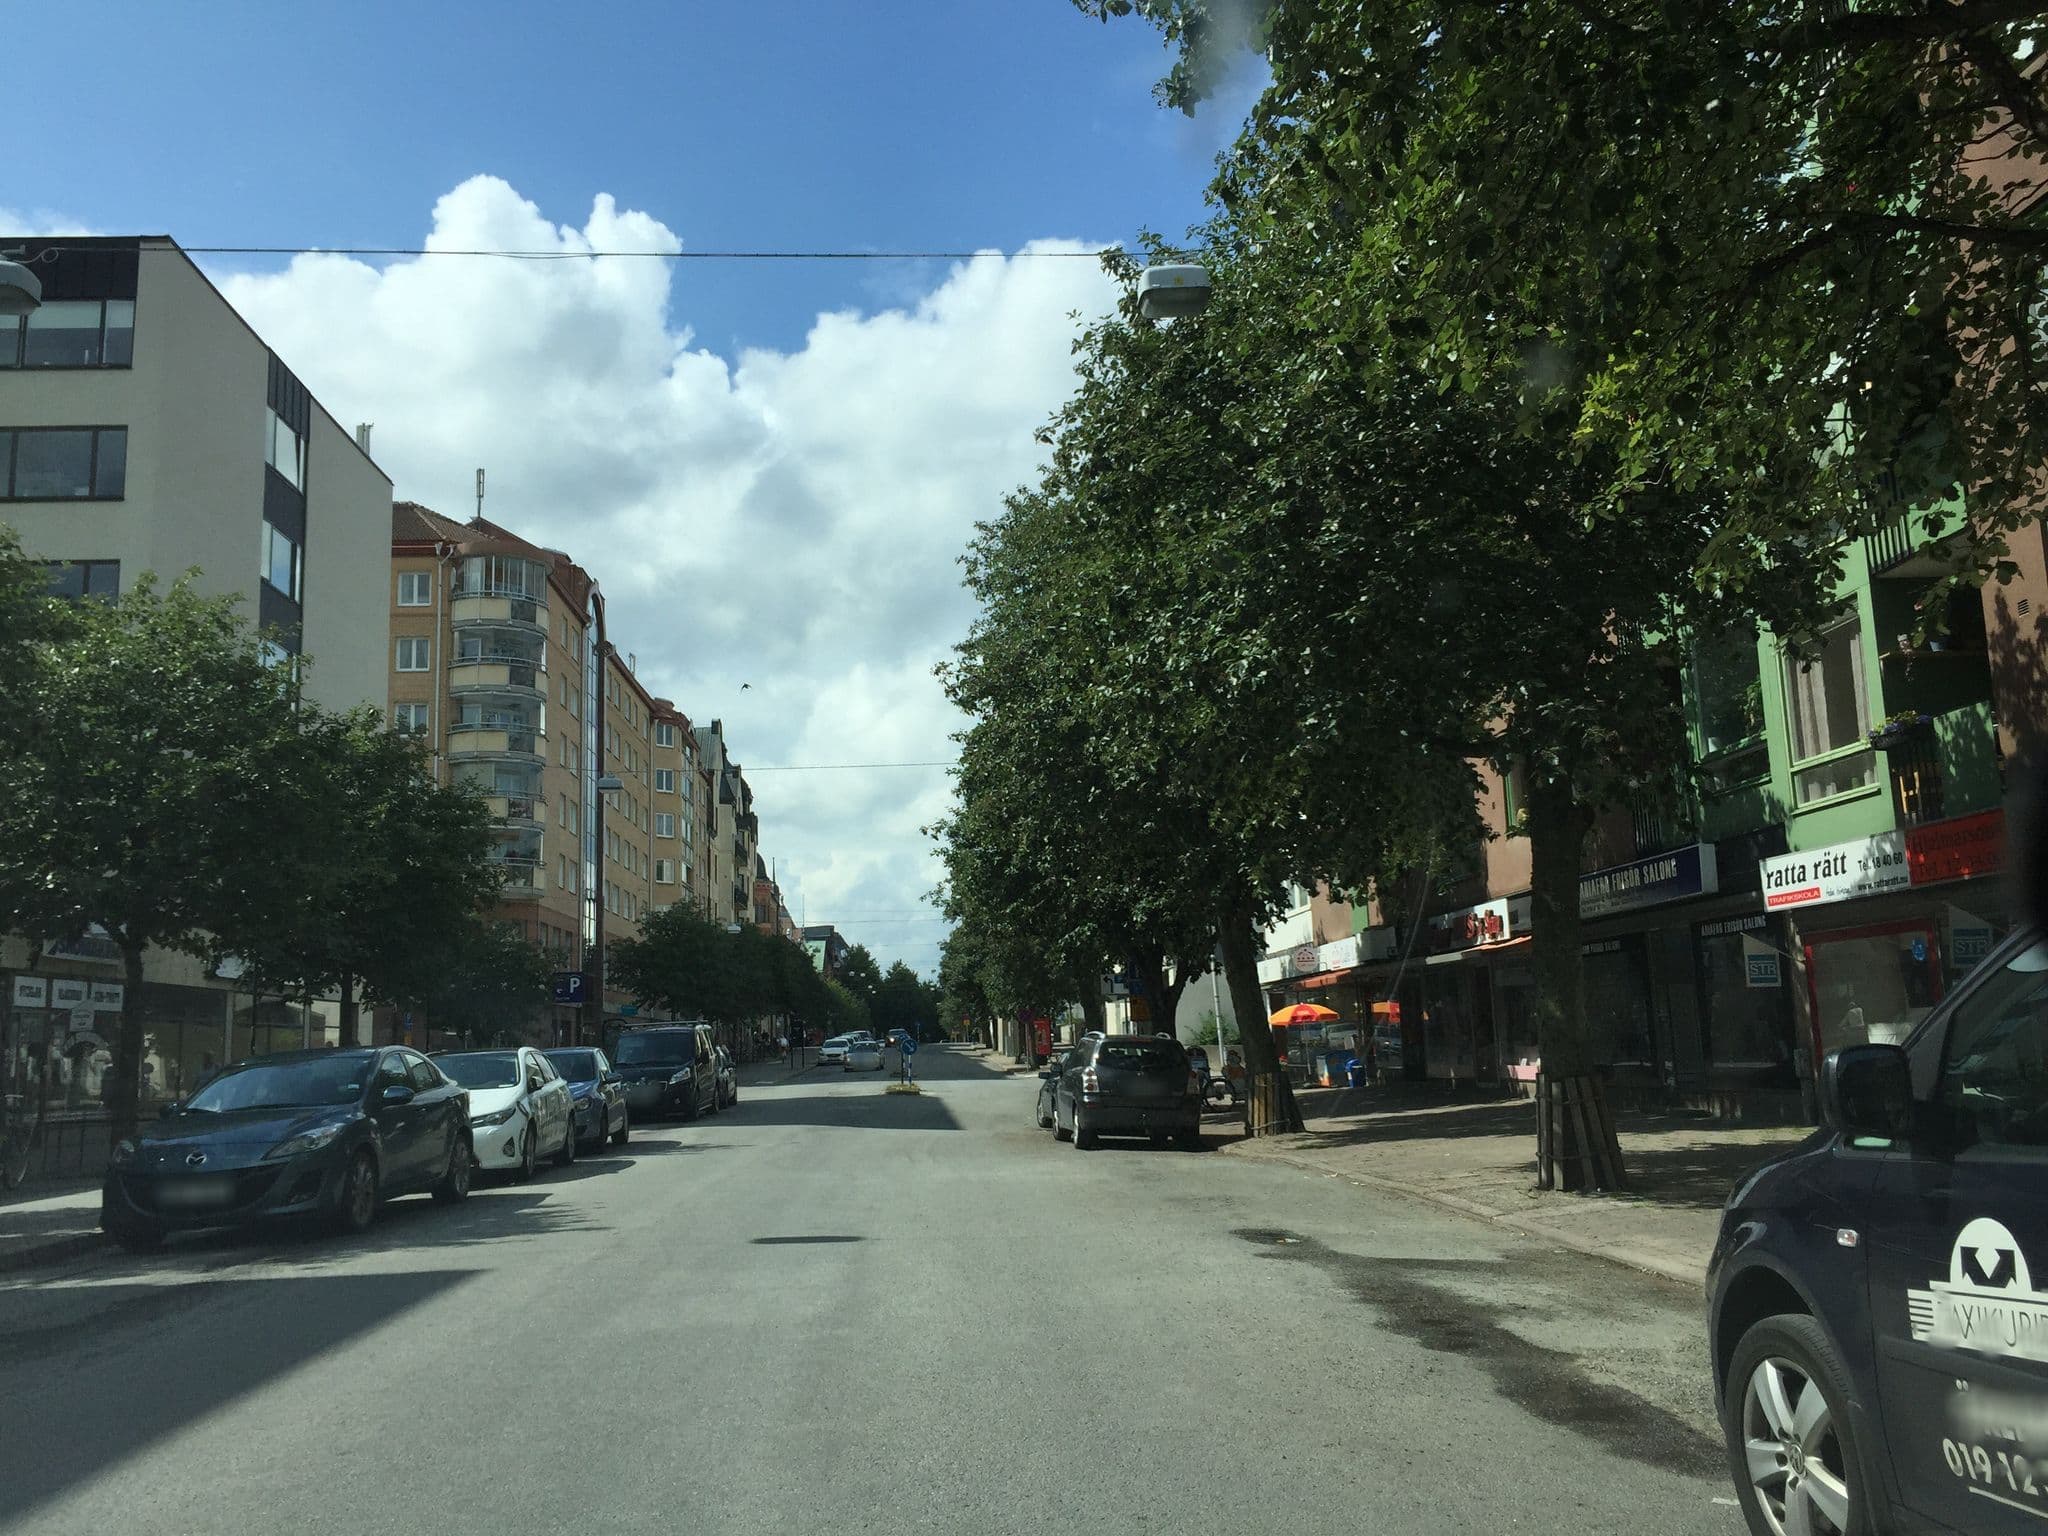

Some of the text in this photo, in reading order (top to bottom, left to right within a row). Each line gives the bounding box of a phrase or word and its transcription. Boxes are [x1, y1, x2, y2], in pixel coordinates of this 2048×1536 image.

[1642, 858, 1678, 884] SALONG
[1766, 851, 1847, 889] ratta rätt
[1857, 852, 1903, 872] Tel. 18 40 60
[1769, 889, 1820, 905] TRAFIKSKOLA
[1750, 963, 1777, 975] STR
[569, 977, 581, 993] P
[1942, 1437, 1993, 1485] 019
